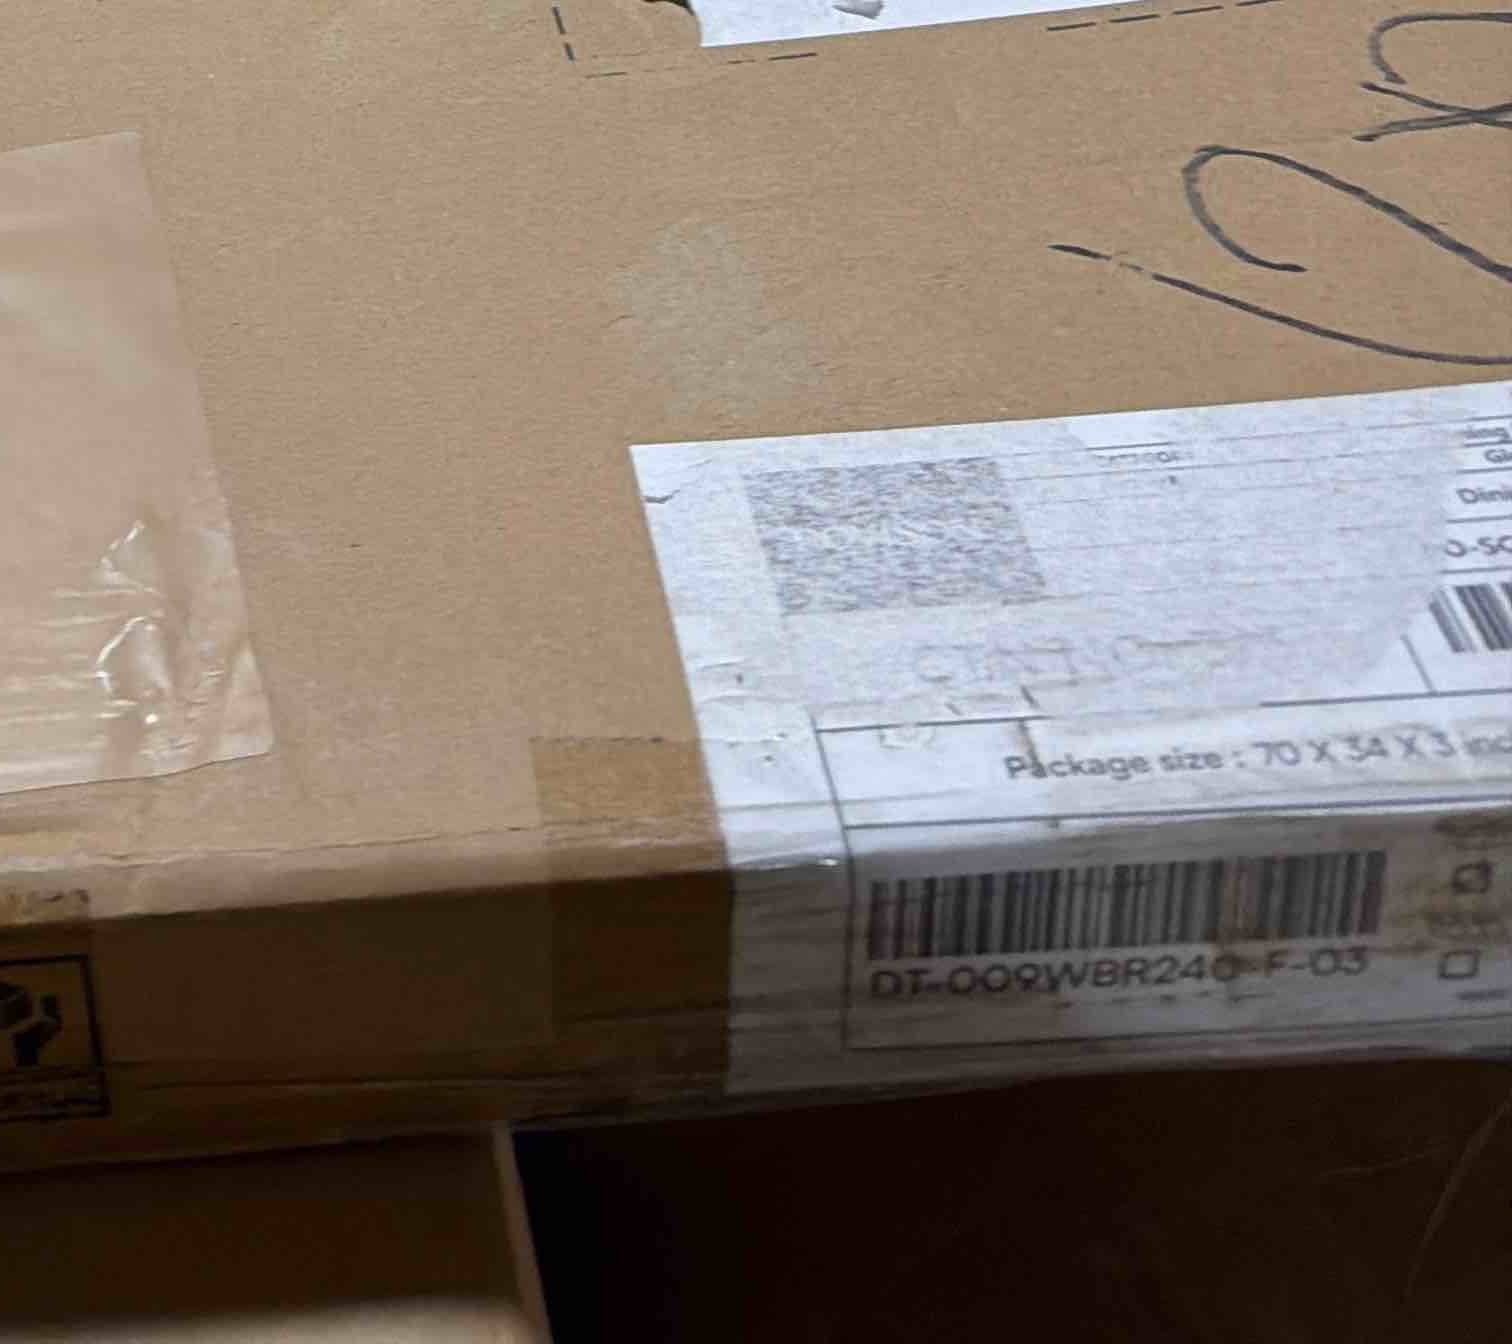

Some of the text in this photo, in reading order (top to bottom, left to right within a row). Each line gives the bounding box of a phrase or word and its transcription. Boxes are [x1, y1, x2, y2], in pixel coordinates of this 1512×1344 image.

[1006, 749, 1152, 782] Package
[1159, 745, 1226, 770] size
[1252, 740, 1302, 766] 70
[870, 944, 1371, 1001] DT-009WBR240-F-03
